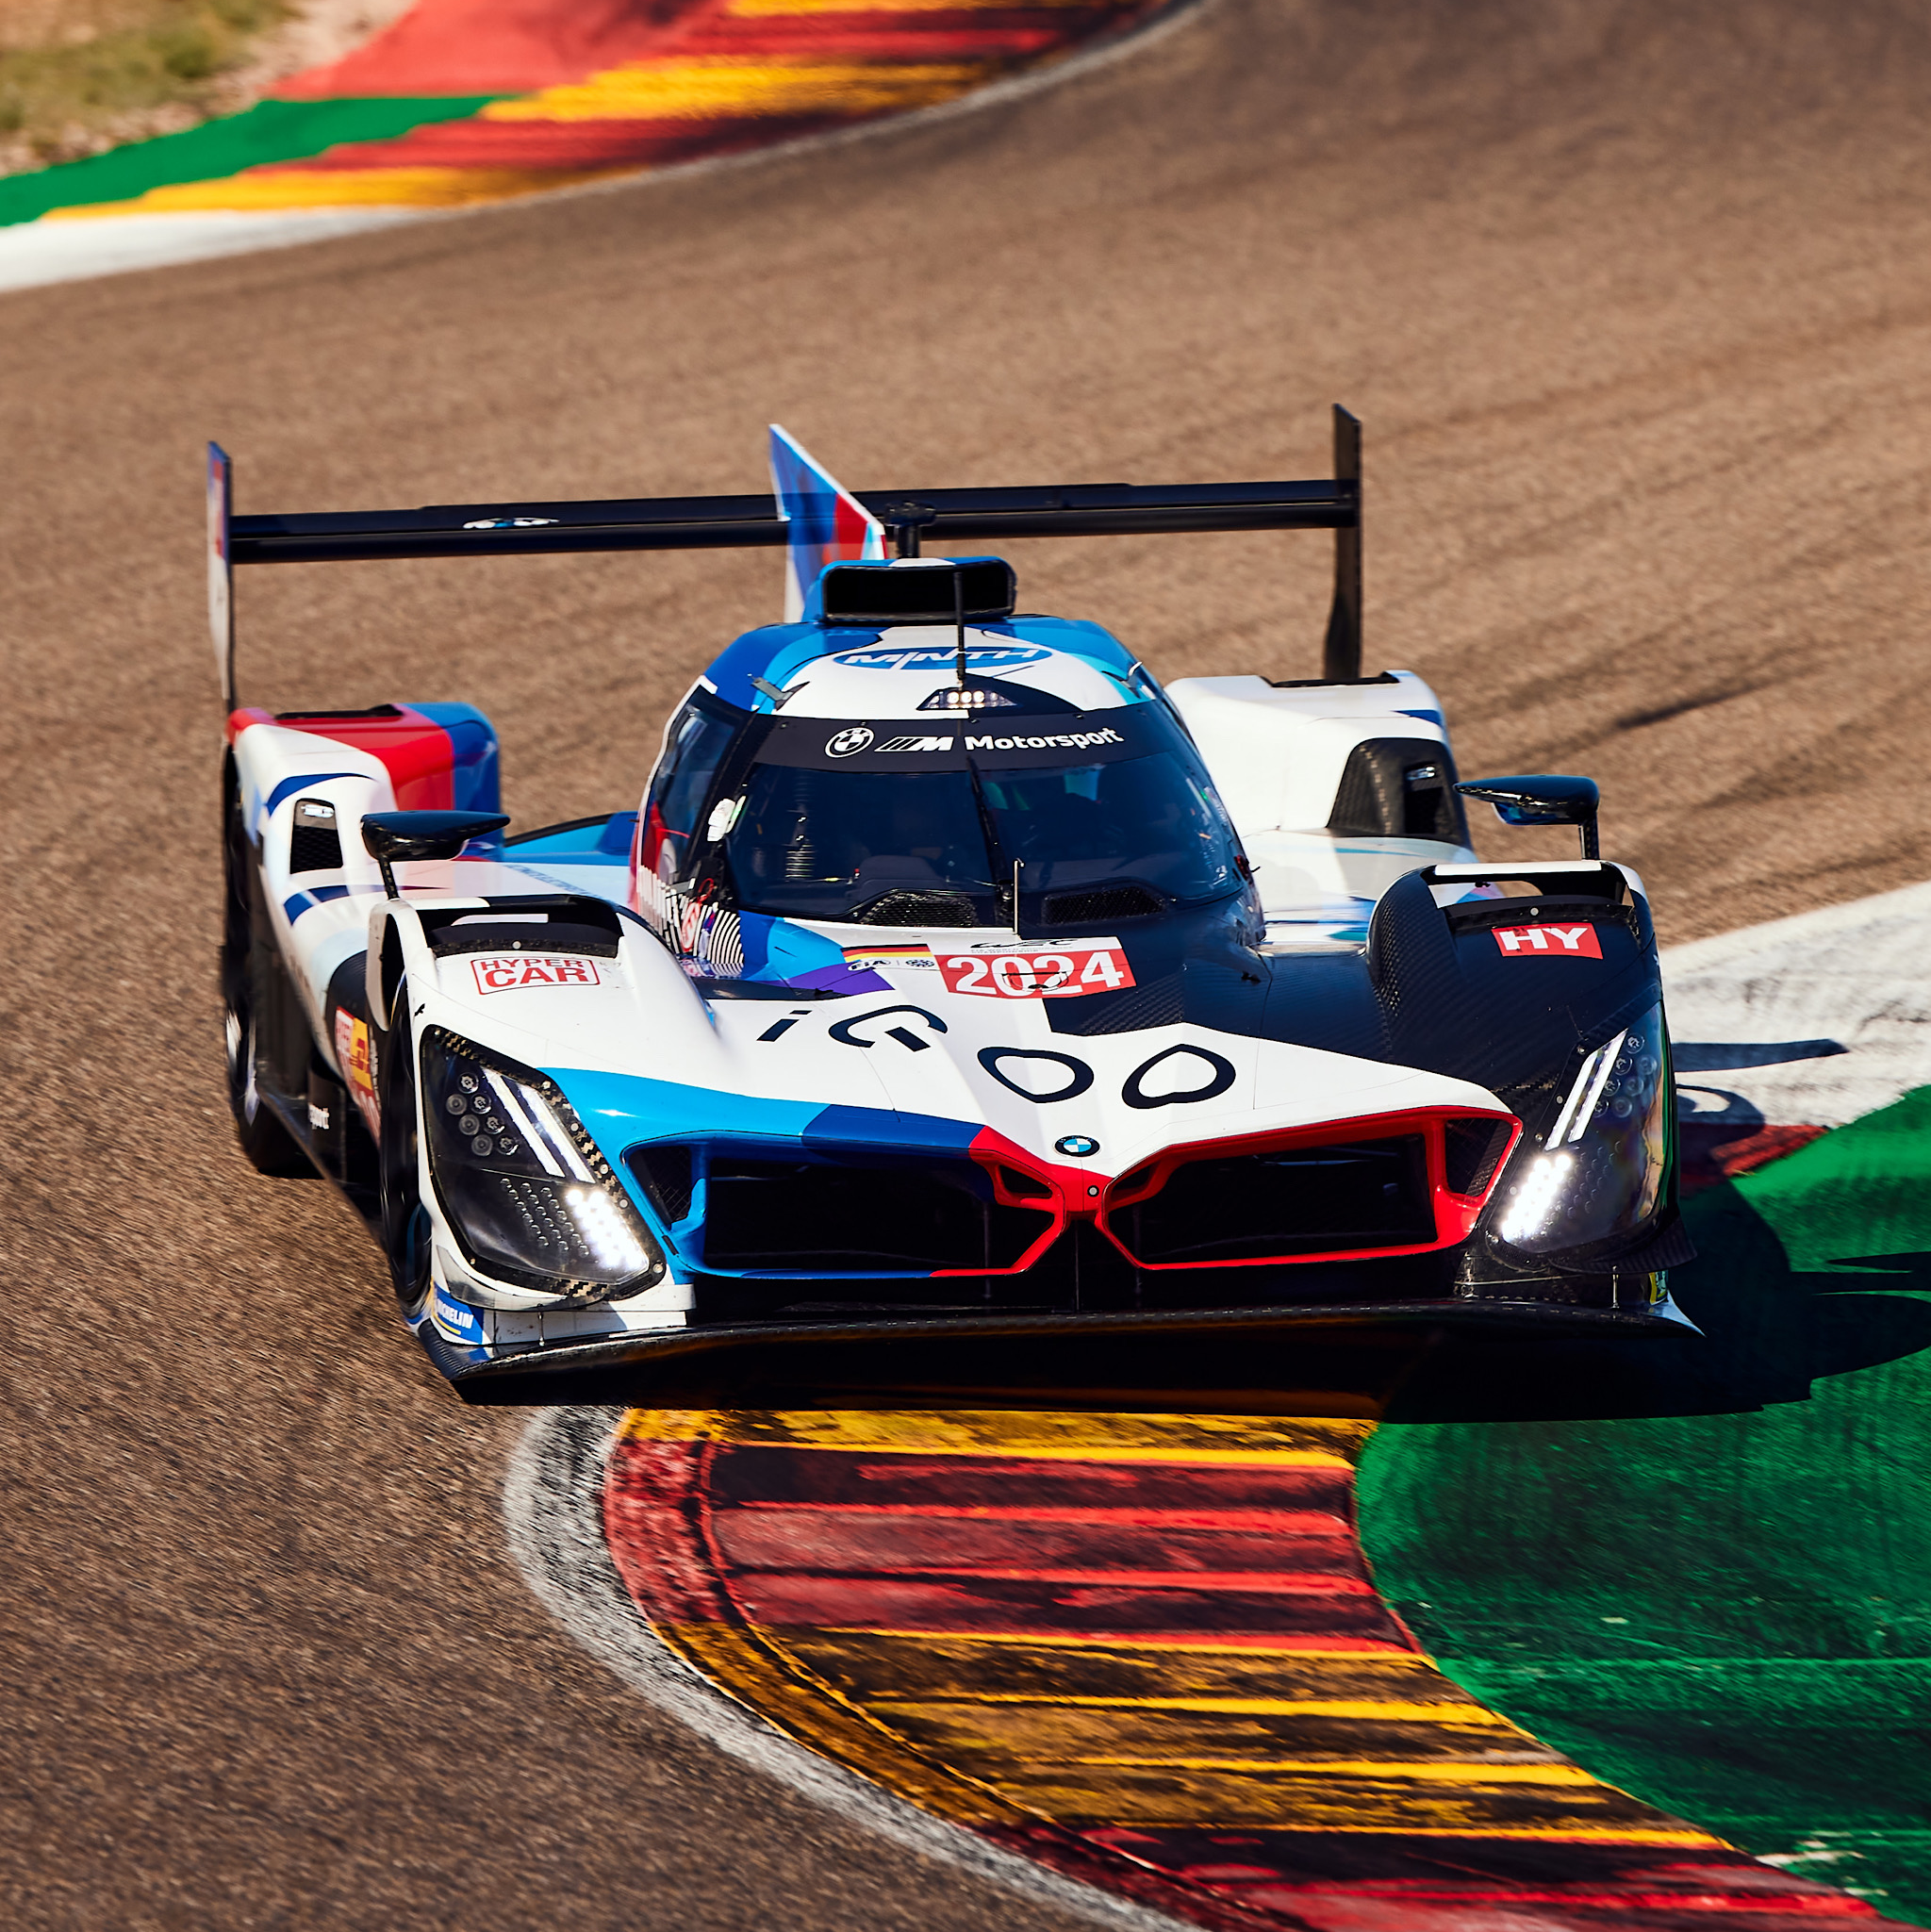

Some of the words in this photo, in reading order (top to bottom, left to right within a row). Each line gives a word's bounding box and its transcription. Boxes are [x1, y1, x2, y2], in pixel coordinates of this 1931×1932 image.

[843, 647, 1034, 669] MINTH
[965, 727, 1124, 750] Motorsport
[1499, 927, 1588, 950] HY
[480, 959, 584, 970] HYPER
[947, 951, 1124, 997] 2024
[486, 967, 588, 987] CAR
